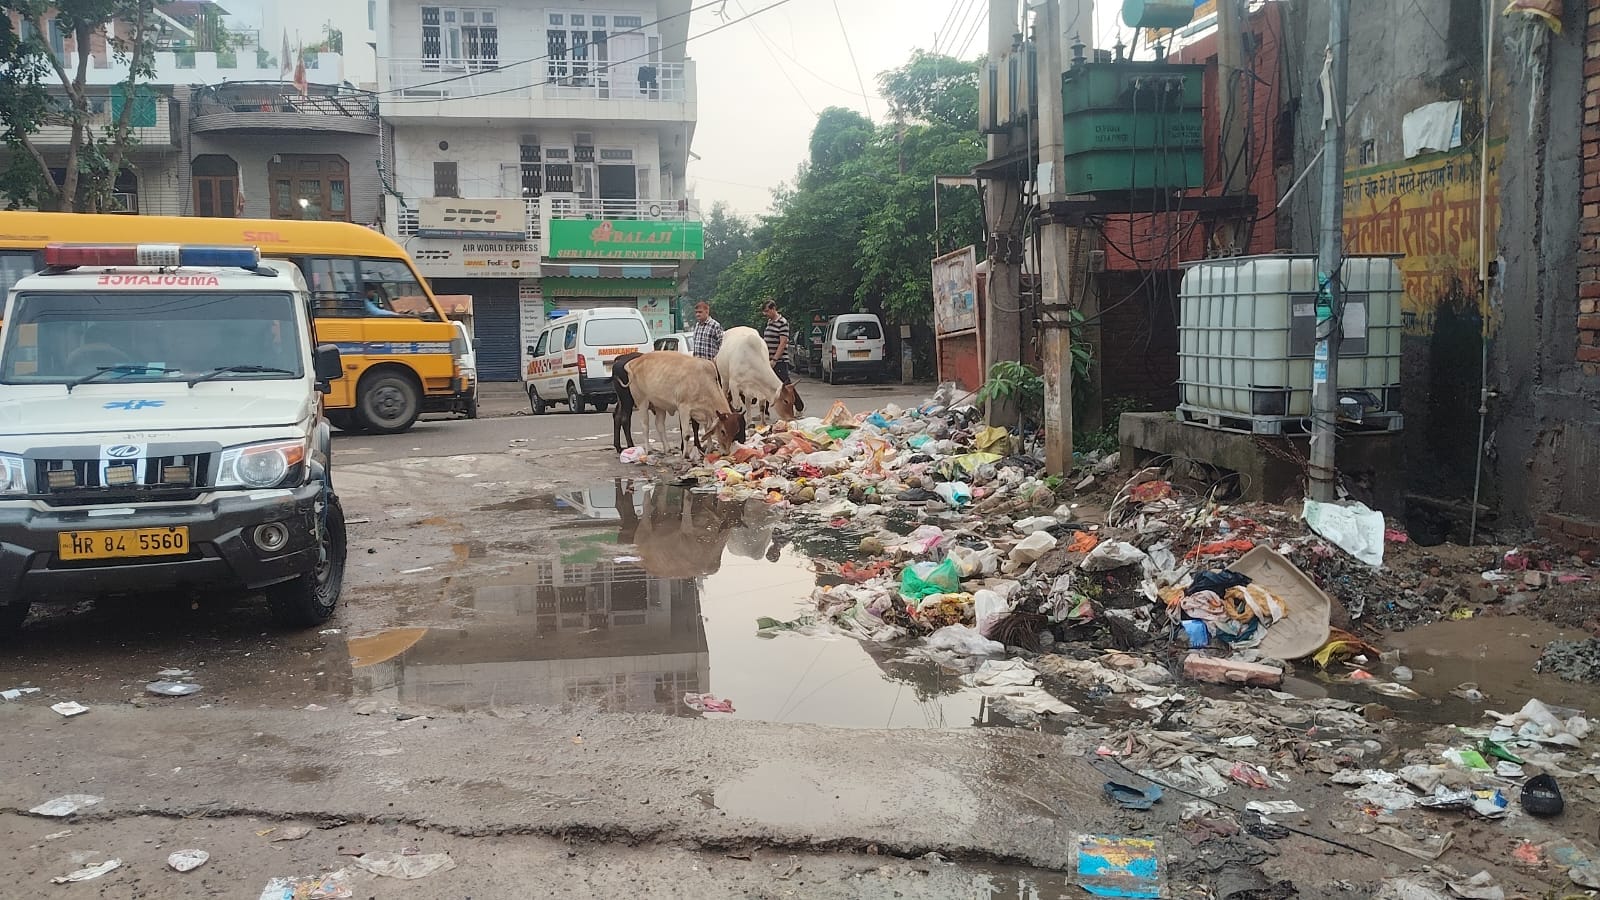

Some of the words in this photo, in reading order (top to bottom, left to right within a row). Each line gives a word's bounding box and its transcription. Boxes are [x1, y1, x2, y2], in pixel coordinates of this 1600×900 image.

[614, 232, 672, 243] BALAJI
[462, 244, 475, 252] AIR
[476, 244, 503, 252] WORLD
[505, 244, 538, 252] EXPRESS
[598, 347, 639, 355] AMBULANCE
[72, 537, 94, 554] HR
[104, 536, 126, 551] 84
[139, 533, 183, 550] 5560
